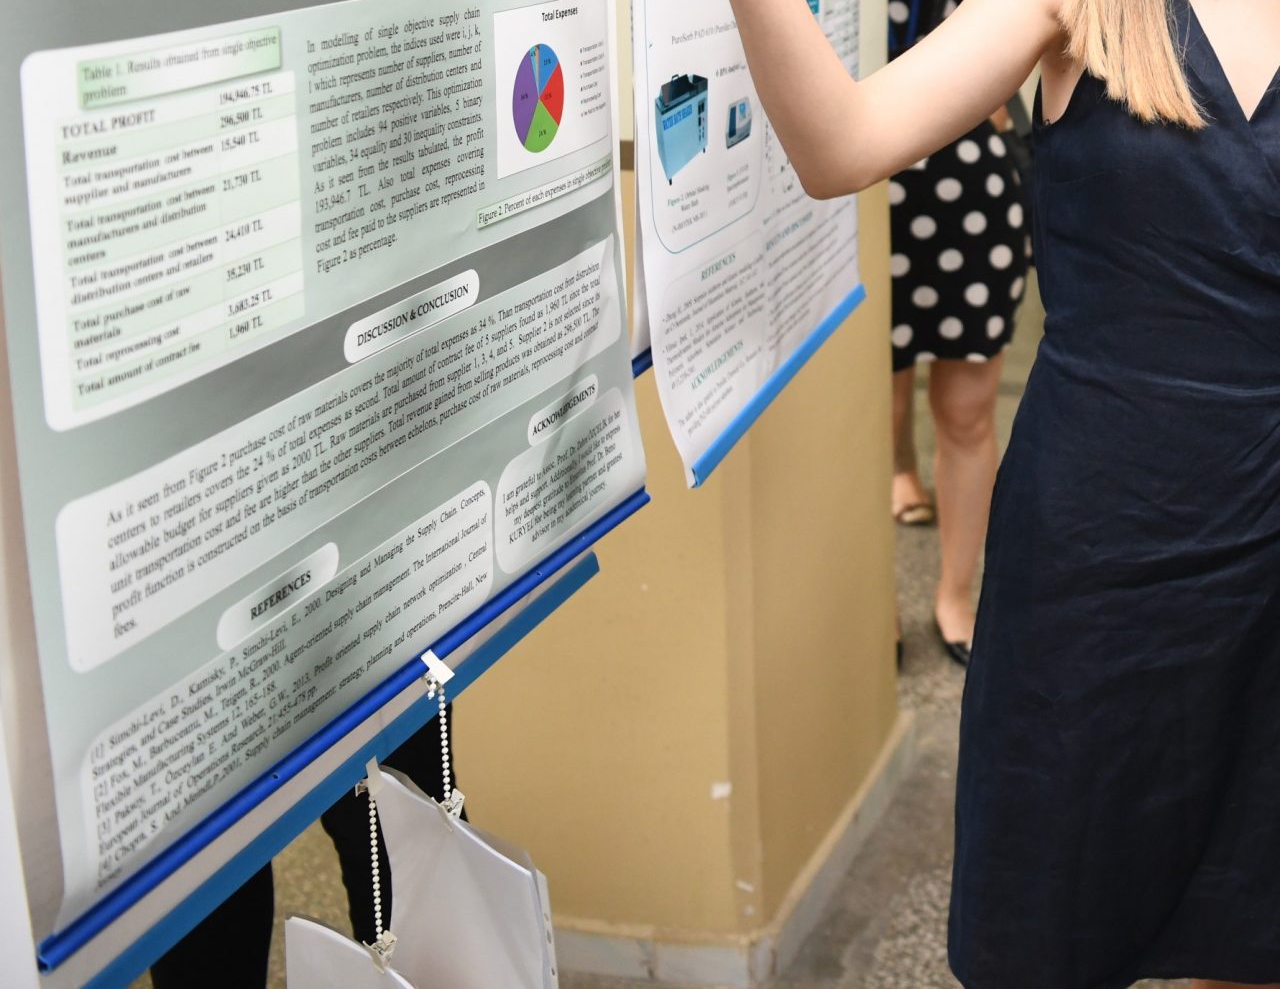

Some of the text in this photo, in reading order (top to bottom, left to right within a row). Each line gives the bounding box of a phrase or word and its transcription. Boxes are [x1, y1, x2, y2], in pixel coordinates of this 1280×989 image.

[307, 8, 480, 54] In modelling of single objective supply chain
[542, 6, 578, 23] Total Expenses
[308, 30, 461, 75] optimization problem, the indices used were
[478, 209, 498, 225] Figure
[504, 199, 524, 214] Percent
[526, 196, 531, 207] of
[532, 192, 544, 203] each
[545, 183, 567, 200] expenses
[317, 251, 341, 273] Figure
[343, 249, 348, 263] 2
[349, 245, 357, 259] as
[357, 283, 470, 347] DISCUSSION & CONCLUSION
[383, 345, 475, 398] Total amount of contract fee
[387, 320, 487, 384] majority of total expenses as 34
[250, 570, 312, 620] REFERENCES
